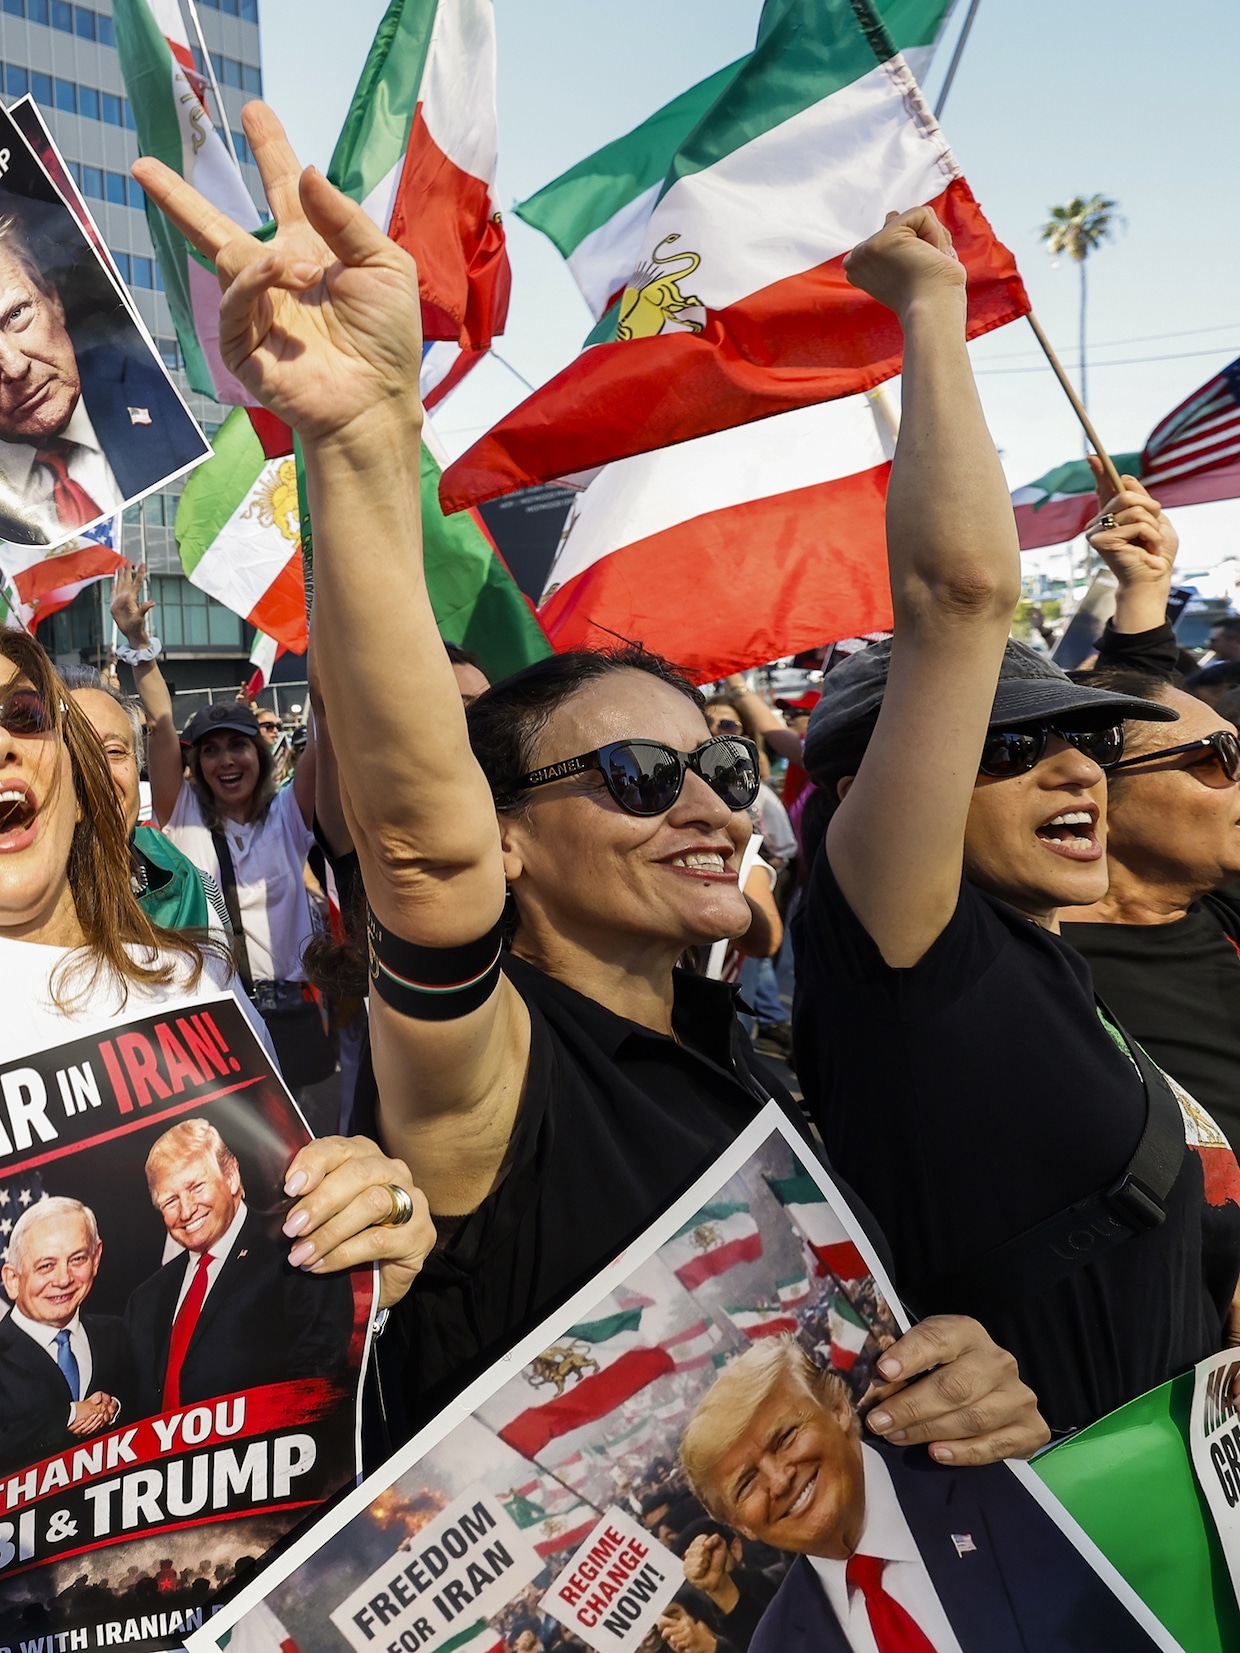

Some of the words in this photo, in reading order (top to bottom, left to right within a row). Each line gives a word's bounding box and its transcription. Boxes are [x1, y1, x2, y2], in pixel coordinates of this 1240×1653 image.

[529, 758, 585, 784] CHANEL
[56, 1061, 102, 1117] IN
[98, 1011, 241, 1115] IRAN!
[157, 1396, 247, 1455] YOU
[45, 1509, 79, 1543] &
[84, 1433, 318, 1537] TRUMP
[352, 1501, 497, 1641] FREEDOM
[385, 1617, 437, 1653] FOR
[432, 1540, 515, 1622] IRAN
[558, 1525, 626, 1608] REGIME
[576, 1537, 649, 1629] CHANGE
[603, 1563, 666, 1640] NOW!
[20, 1627, 89, 1653] WITH
[96, 1606, 203, 1646] IRANIAN
